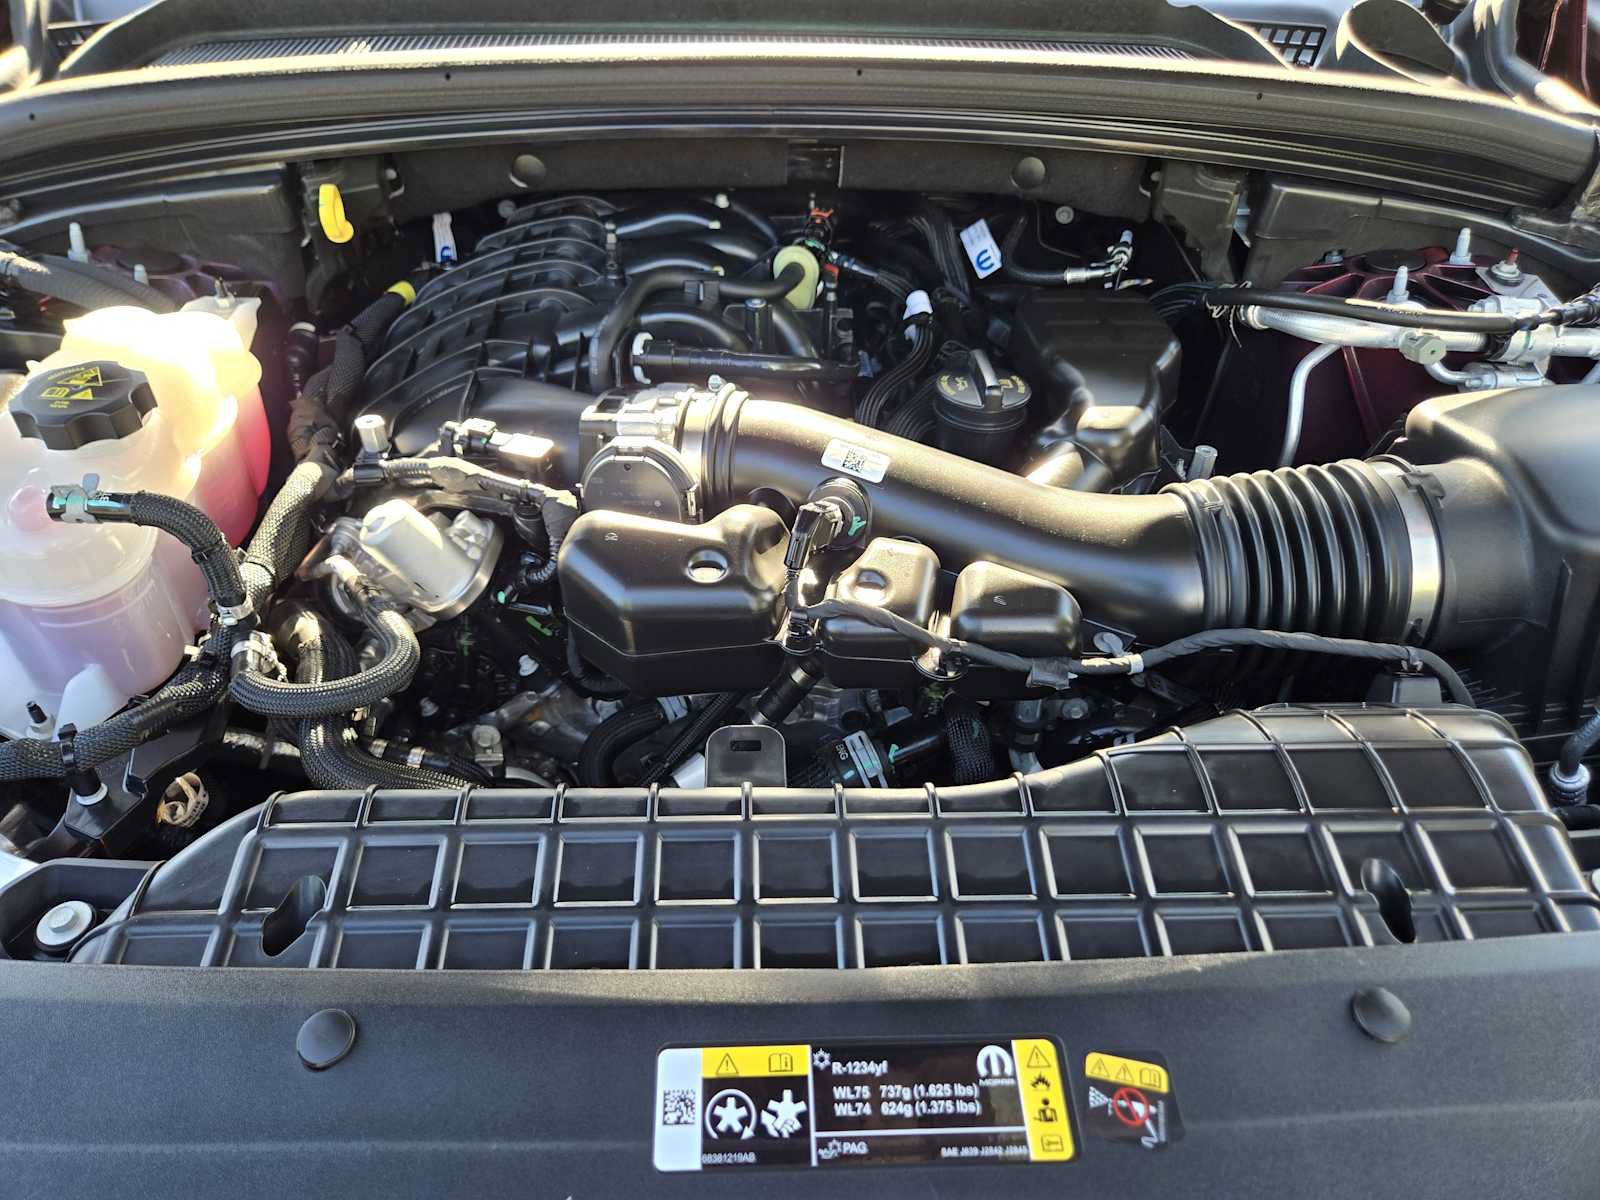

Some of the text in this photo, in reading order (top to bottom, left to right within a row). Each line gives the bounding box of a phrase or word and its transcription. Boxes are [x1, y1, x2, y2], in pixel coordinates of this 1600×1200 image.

[832, 1061, 887, 1076] R-1234yf
[833, 1083, 980, 1100] WL75 737g (1.625 lbs)
[834, 1100, 982, 1117] WL74 624g (1.375 lbs)
[843, 1142, 868, 1155] PAG
